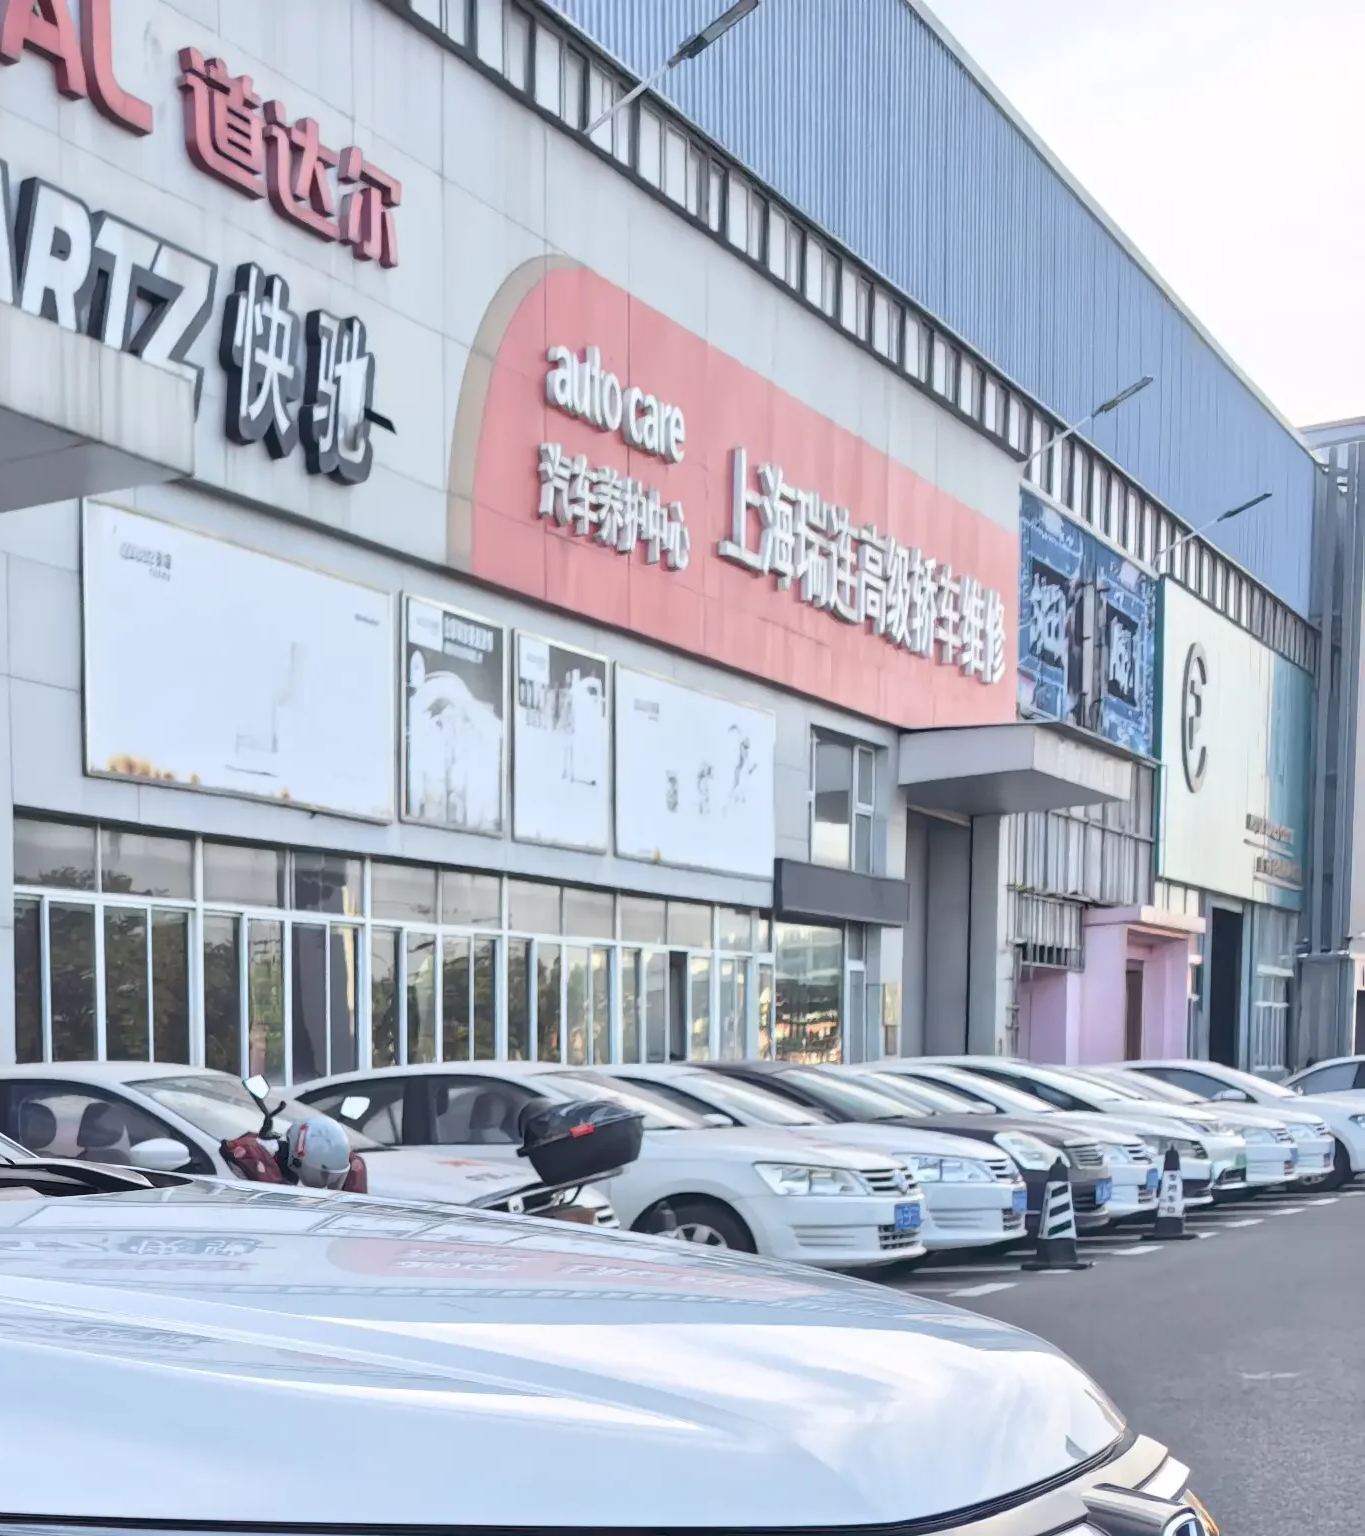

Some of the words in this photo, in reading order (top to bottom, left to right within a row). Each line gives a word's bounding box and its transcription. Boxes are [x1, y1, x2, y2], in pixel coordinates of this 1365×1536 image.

[177, 47, 402, 269] 道达尔
[220, 262, 375, 484] 快驰
[545, 345, 622, 433] auto
[621, 386, 686, 464] care
[537, 442, 690, 571] 汽车养护中心
